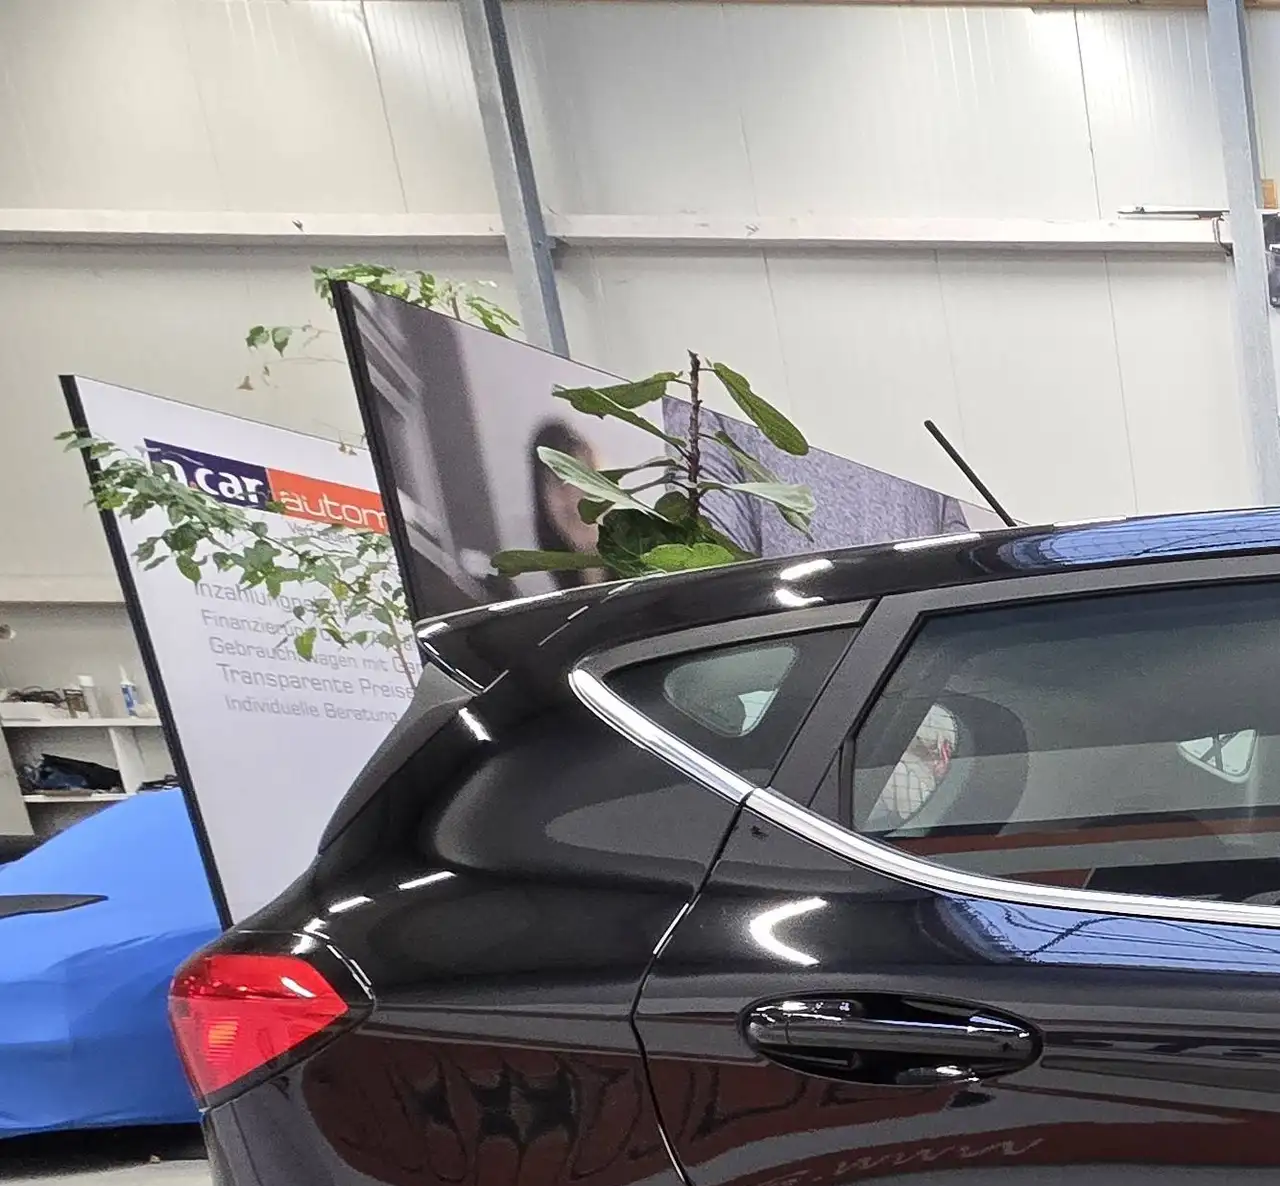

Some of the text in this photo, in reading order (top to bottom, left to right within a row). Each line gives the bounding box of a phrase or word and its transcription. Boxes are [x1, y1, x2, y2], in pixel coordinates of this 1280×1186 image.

[201, 608, 311, 641] Finanzierun
[216, 662, 355, 694] Transparente
[225, 694, 320, 719] Individuelle
